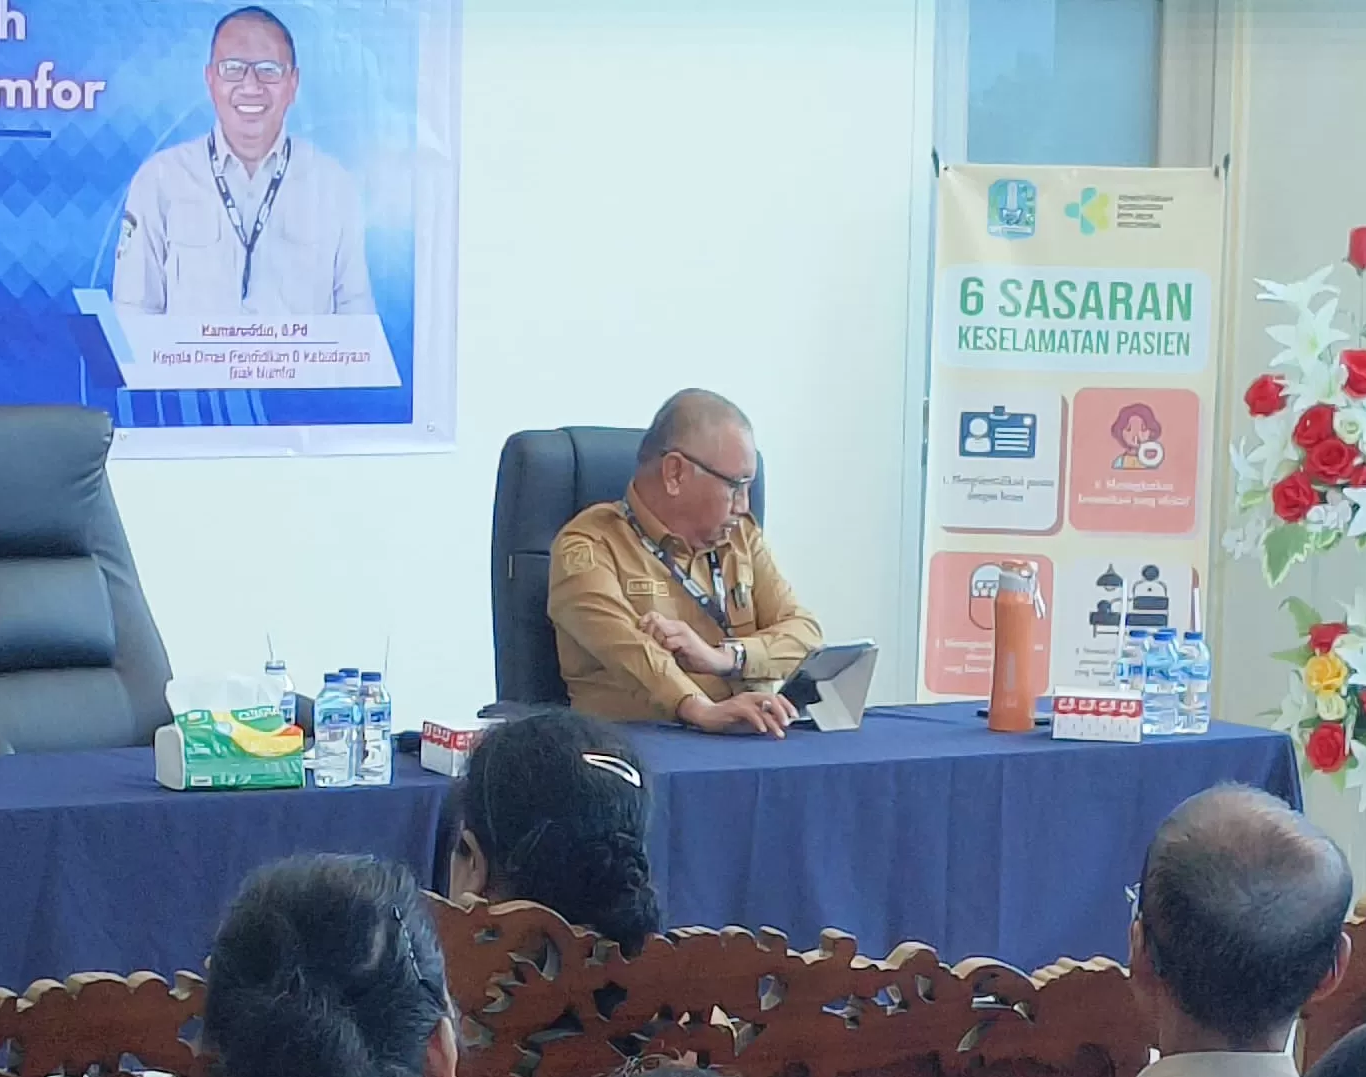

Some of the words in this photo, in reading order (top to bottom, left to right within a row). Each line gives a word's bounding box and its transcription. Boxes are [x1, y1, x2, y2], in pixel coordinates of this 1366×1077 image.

[959, 276, 985, 316] 6
[997, 277, 1194, 322] SASARAN
[957, 325, 1110, 355] KESELAMATAN
[1115, 329, 1191, 357] PASIEN
